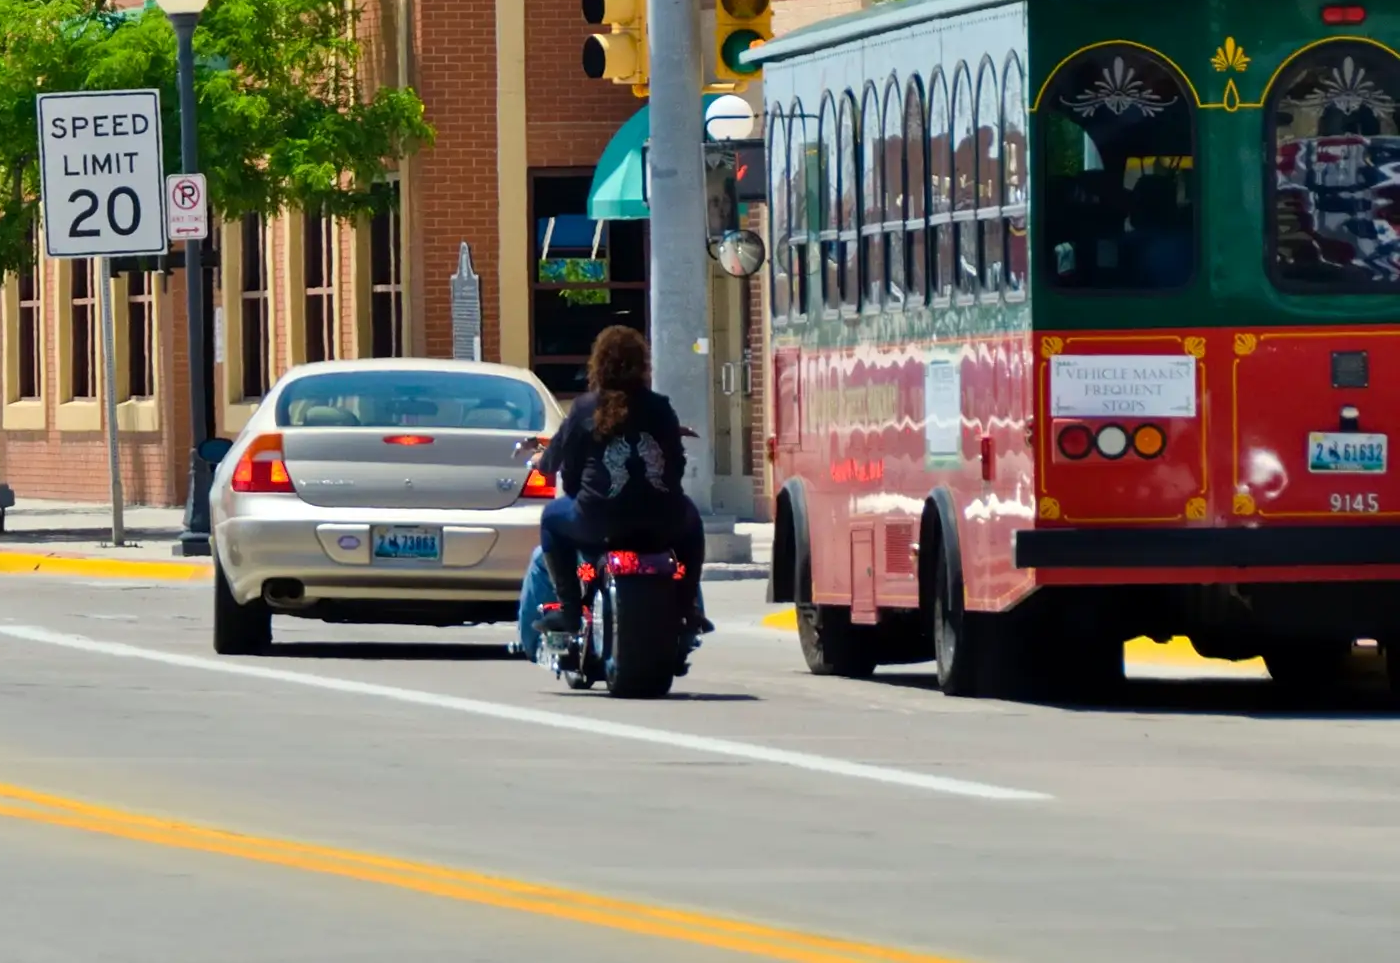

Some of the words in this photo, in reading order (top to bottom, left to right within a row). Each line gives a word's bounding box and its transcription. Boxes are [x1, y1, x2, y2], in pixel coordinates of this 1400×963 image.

[51, 114, 149, 139] SPEED
[64, 152, 139, 176] LIMIT
[68, 186, 141, 237] 20
[1066, 368, 1128, 380] VEHICLE
[1133, 368, 1185, 379] MAKES
[1084, 384, 1164, 396] FREQUENT
[1102, 400, 1146, 412] STOPS
[1330, 493, 1379, 512] 9145
